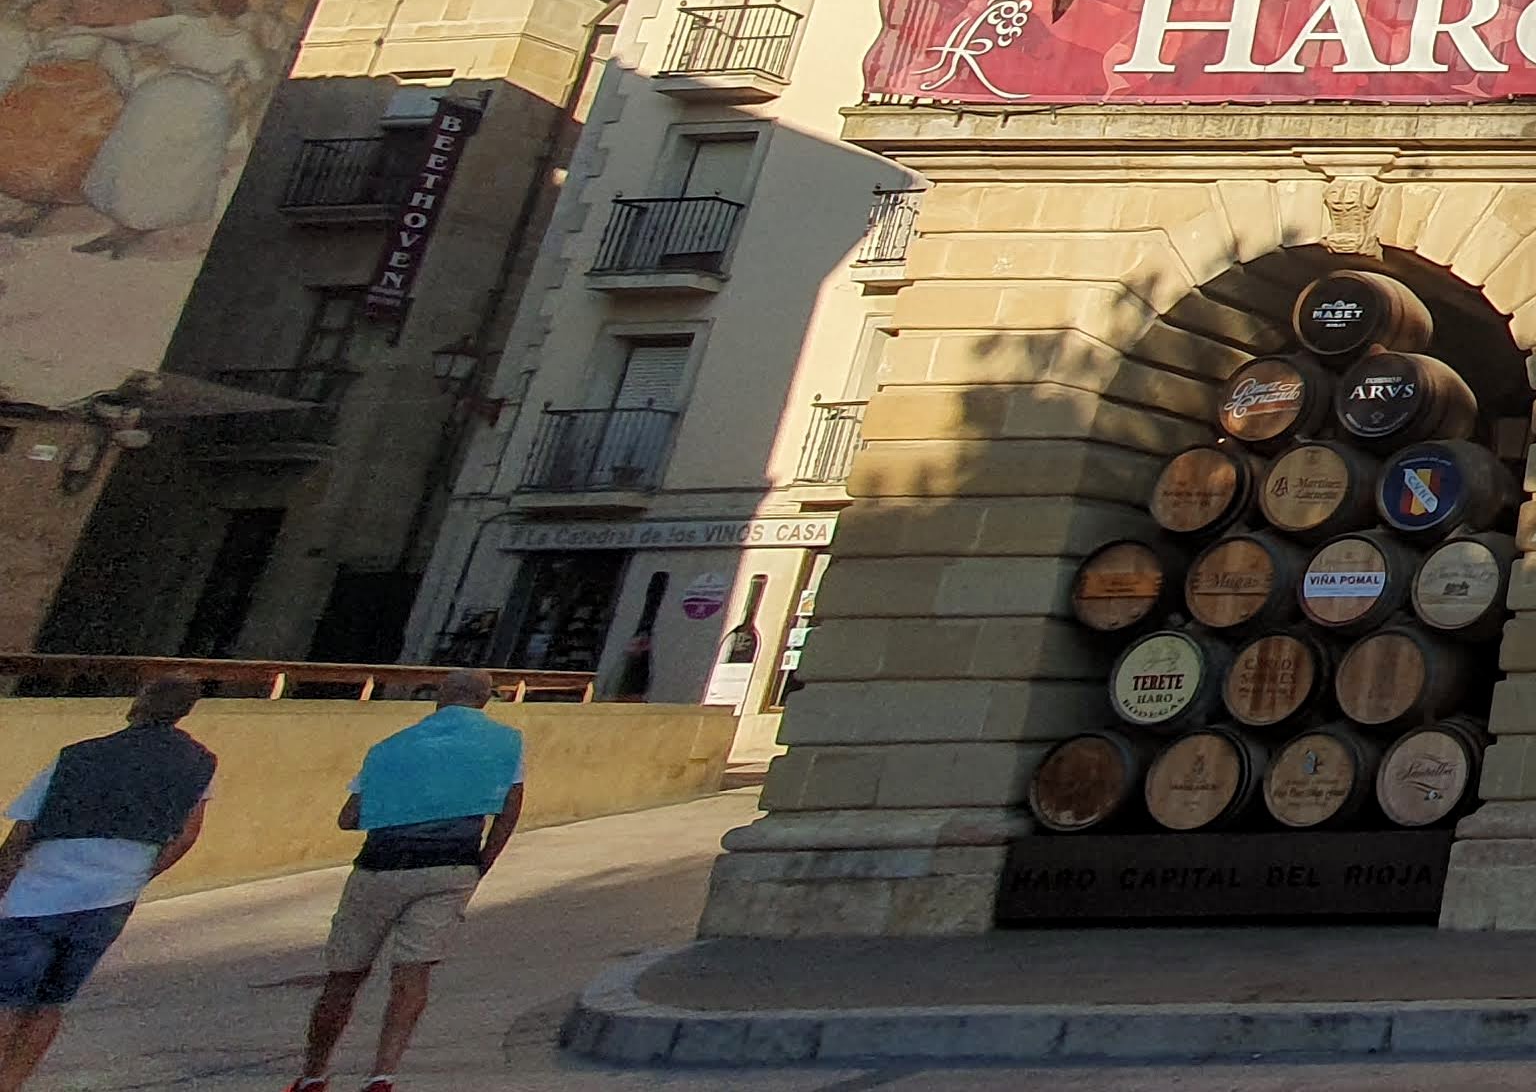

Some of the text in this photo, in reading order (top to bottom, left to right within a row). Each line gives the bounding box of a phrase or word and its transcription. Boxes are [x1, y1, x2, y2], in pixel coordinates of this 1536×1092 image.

[381, 115, 462, 289] BEETHOVEN
[1312, 310, 1363, 319] MASET
[704, 523, 764, 543] VINOS
[776, 523, 828, 541] CASA
[1310, 574, 1380, 585] VIÑA POMAL
[1132, 673, 1185, 691] TERETE
[1119, 865, 1243, 891] CAPITAL
[1266, 864, 1322, 888] DEL
[1343, 863, 1434, 887] RIOJA
